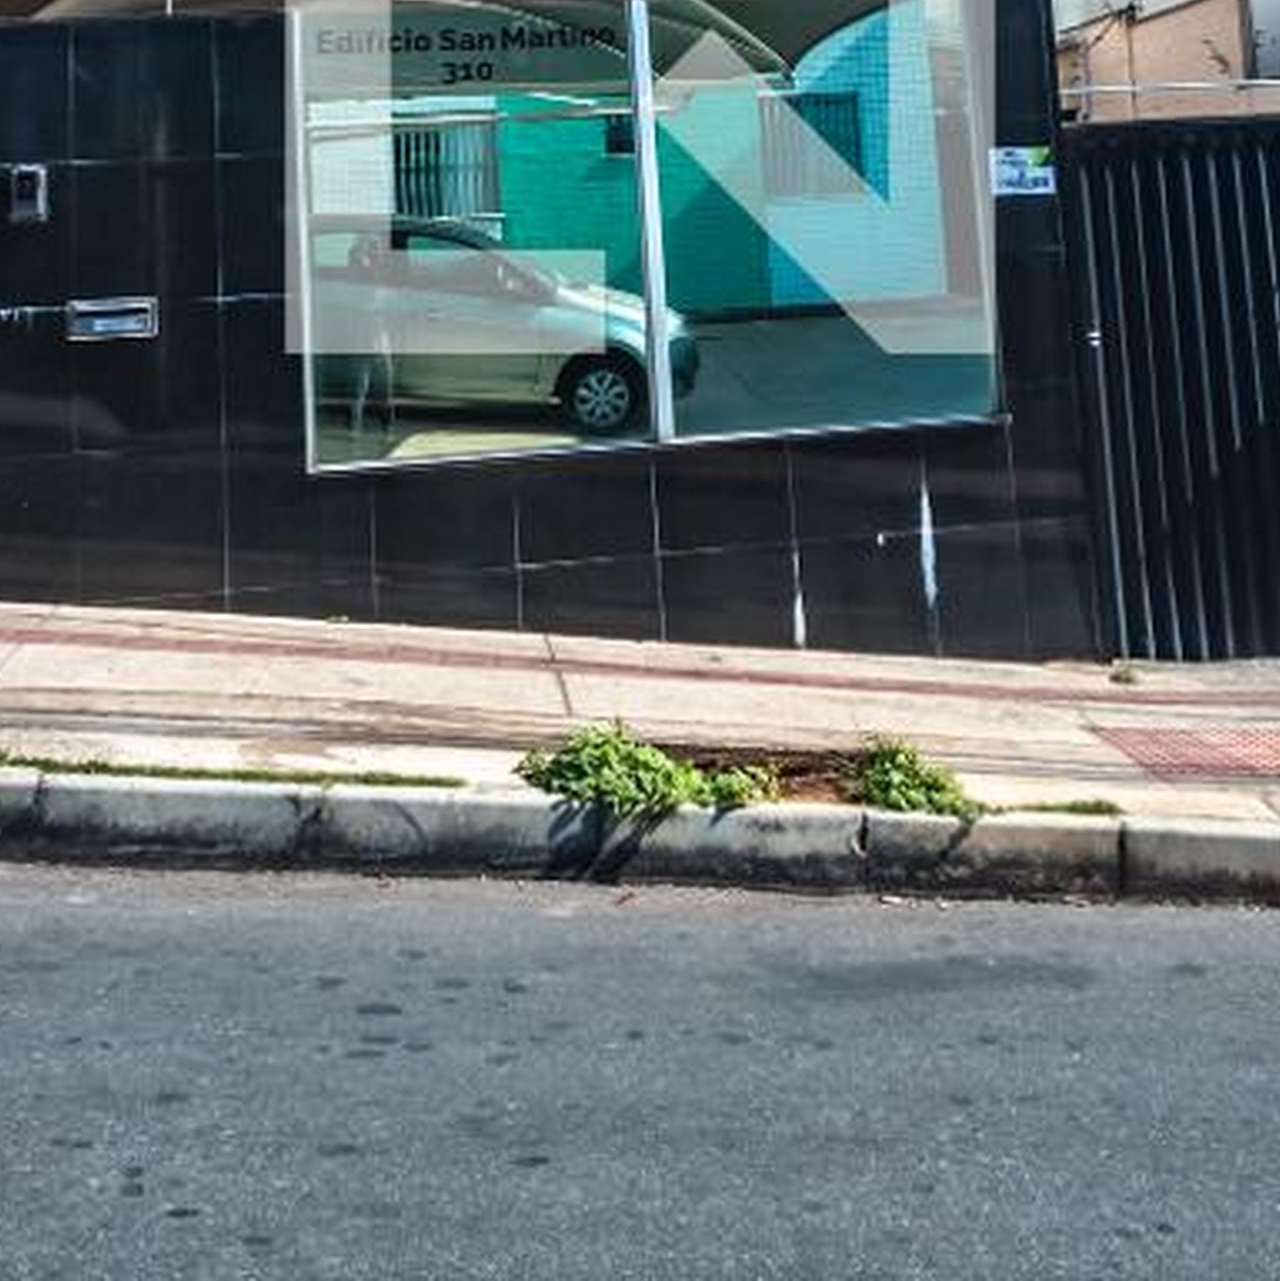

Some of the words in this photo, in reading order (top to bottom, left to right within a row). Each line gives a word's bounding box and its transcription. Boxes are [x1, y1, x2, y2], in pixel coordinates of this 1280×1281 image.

[439, 29, 495, 51] San
[501, 25, 616, 49] Martino
[442, 62, 493, 84] 310
